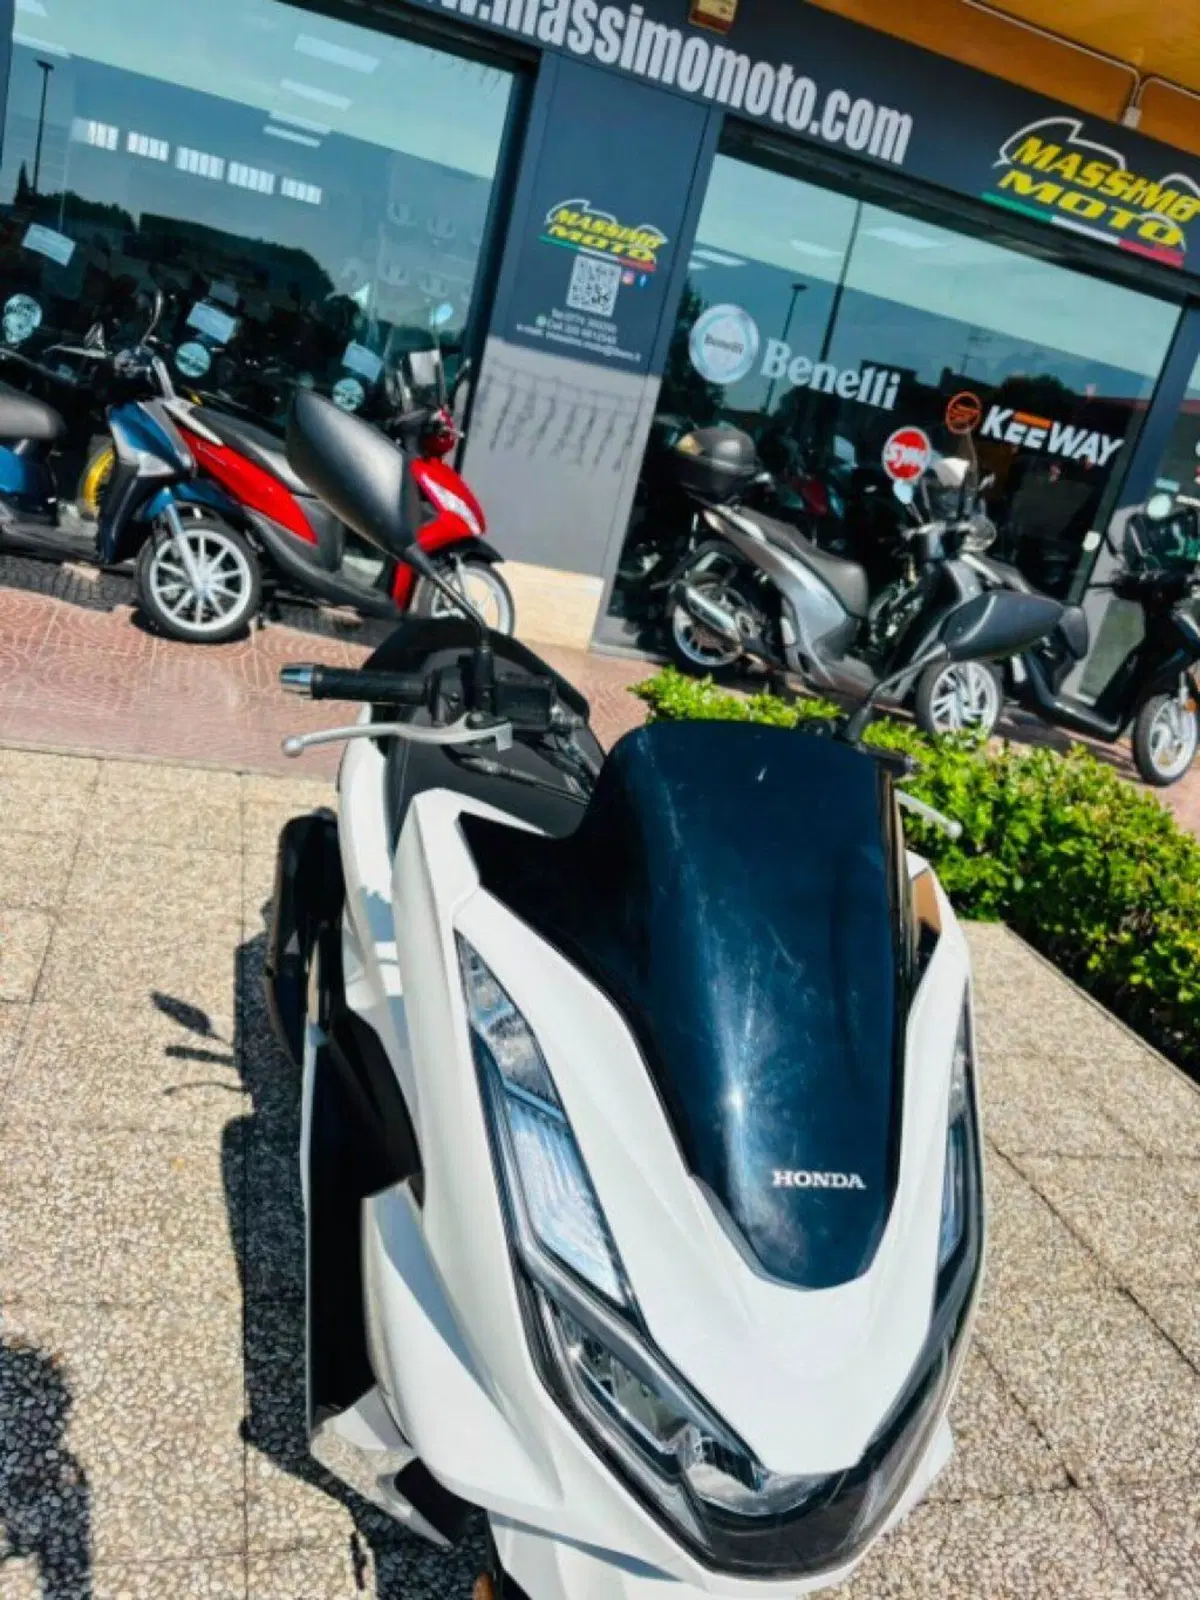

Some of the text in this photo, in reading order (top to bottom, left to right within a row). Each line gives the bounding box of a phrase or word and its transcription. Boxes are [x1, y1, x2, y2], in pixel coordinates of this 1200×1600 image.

[997, 169, 1183, 246] MOTO
[1011, 136, 1200, 222] MASSIMO
[548, 224, 656, 262] MOTO
[553, 208, 662, 249] MASSIMO
[760, 337, 901, 410] Benelli
[771, 1169, 867, 1190] HONDA
